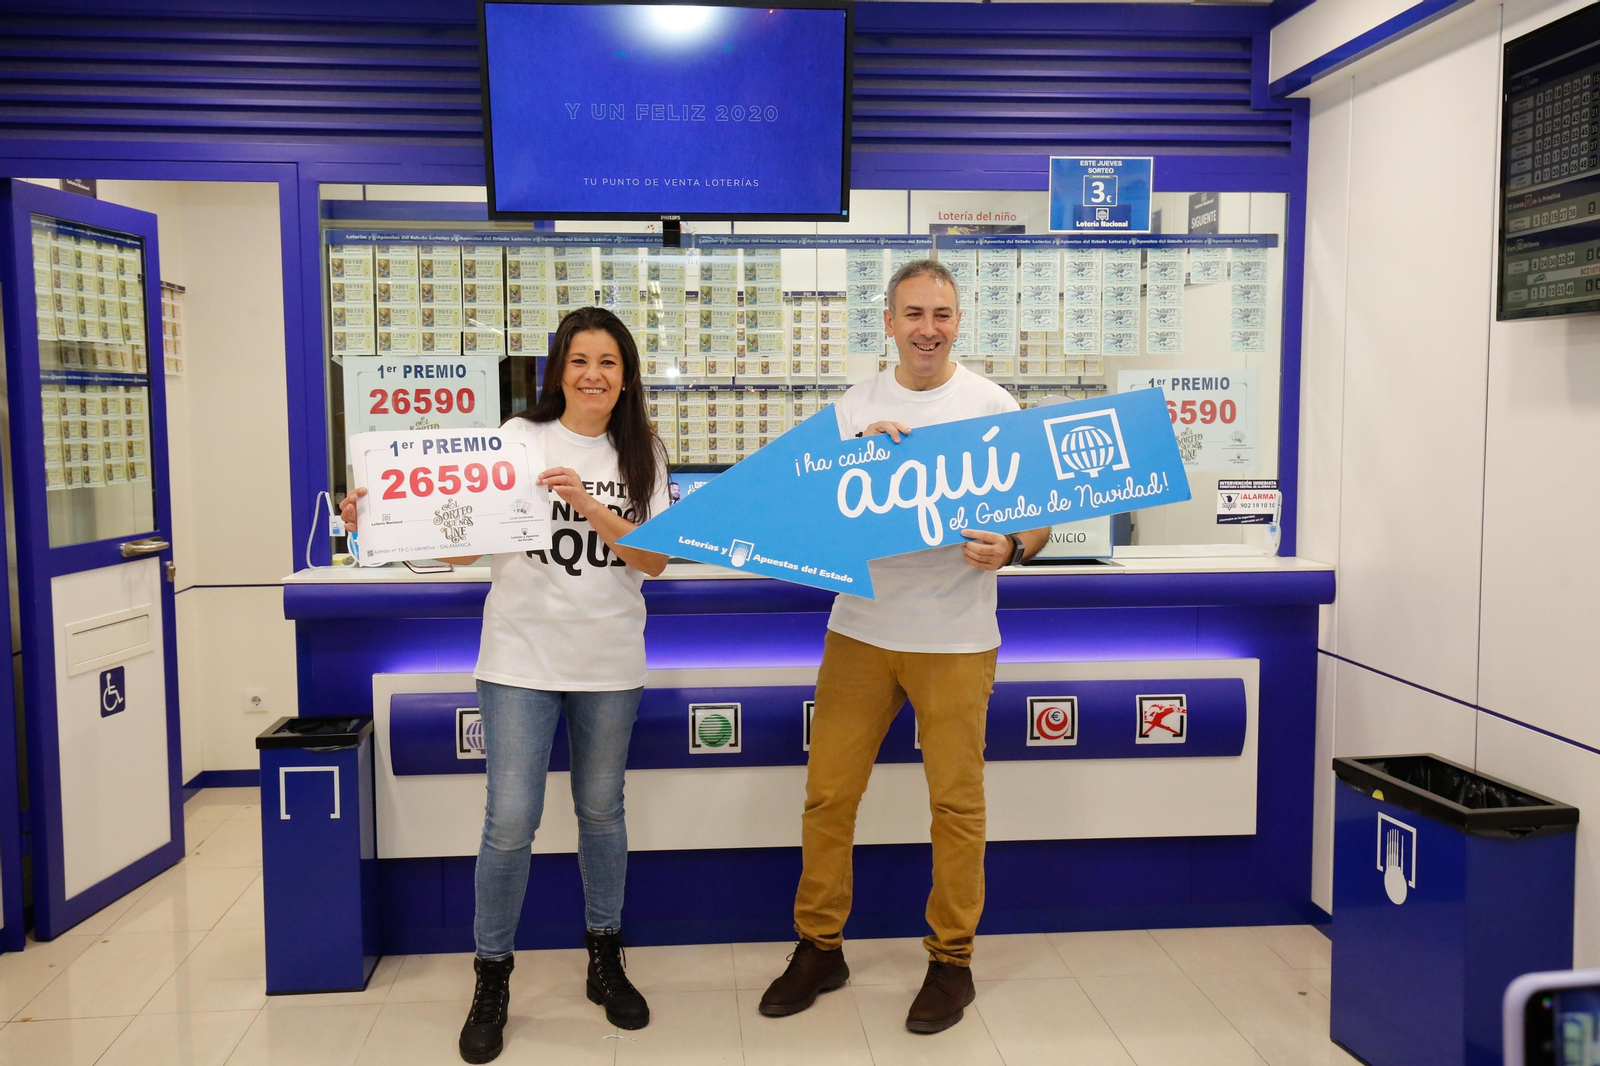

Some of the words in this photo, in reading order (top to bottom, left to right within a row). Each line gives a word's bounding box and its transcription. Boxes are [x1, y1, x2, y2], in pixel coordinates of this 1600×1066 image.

[565, 103, 580, 119] Y
[591, 103, 625, 120] UN
[636, 104, 706, 121] FELIZ
[716, 105, 779, 122] 2020
[583, 177, 597, 186] TU
[602, 177, 640, 187] PUNTO
[644, 178, 659, 187] DE
[664, 178, 701, 187] VENTA
[705, 177, 759, 187] LOTERÍAS
[938, 211, 973, 221] Lotería
[976, 211, 991, 221] del
[994, 212, 1017, 221] niño
[1076, 220, 1099, 228] Lotería
[1101, 220, 1128, 228] Nacional
[377, 364, 397, 379] 1er
[403, 364, 467, 379] PREMIO
[1148, 378, 1166, 388] 1er
[1171, 377, 1230, 391] PREMIO
[369, 387, 475, 414] 26590
[1166, 399, 1236, 425] 6590
[390, 440, 414, 457] 1er
[422, 436, 502, 455] PREMIO
[838, 440, 891, 467] caido
[381, 460, 515, 500] 26590
[837, 425, 1020, 546] aquí
[441, 498, 460, 511] EL
[949, 506, 968, 530] el
[975, 495, 1042, 524] Gordo
[1047, 489, 1072, 512] de
[1074, 471, 1169, 508] Navidad!
[433, 505, 473, 526] SORTEO
[443, 520, 458, 528] QUE
[459, 516, 474, 527] NOS
[440, 527, 467, 544] UNE
[440, 542, 472, 550] SALAMANCA
[678, 536, 719, 552] Loterías
[721, 547, 728, 555] y
[752, 553, 799, 571] Apuestas
[801, 565, 817, 575] del
[818, 569, 853, 583] Estado
